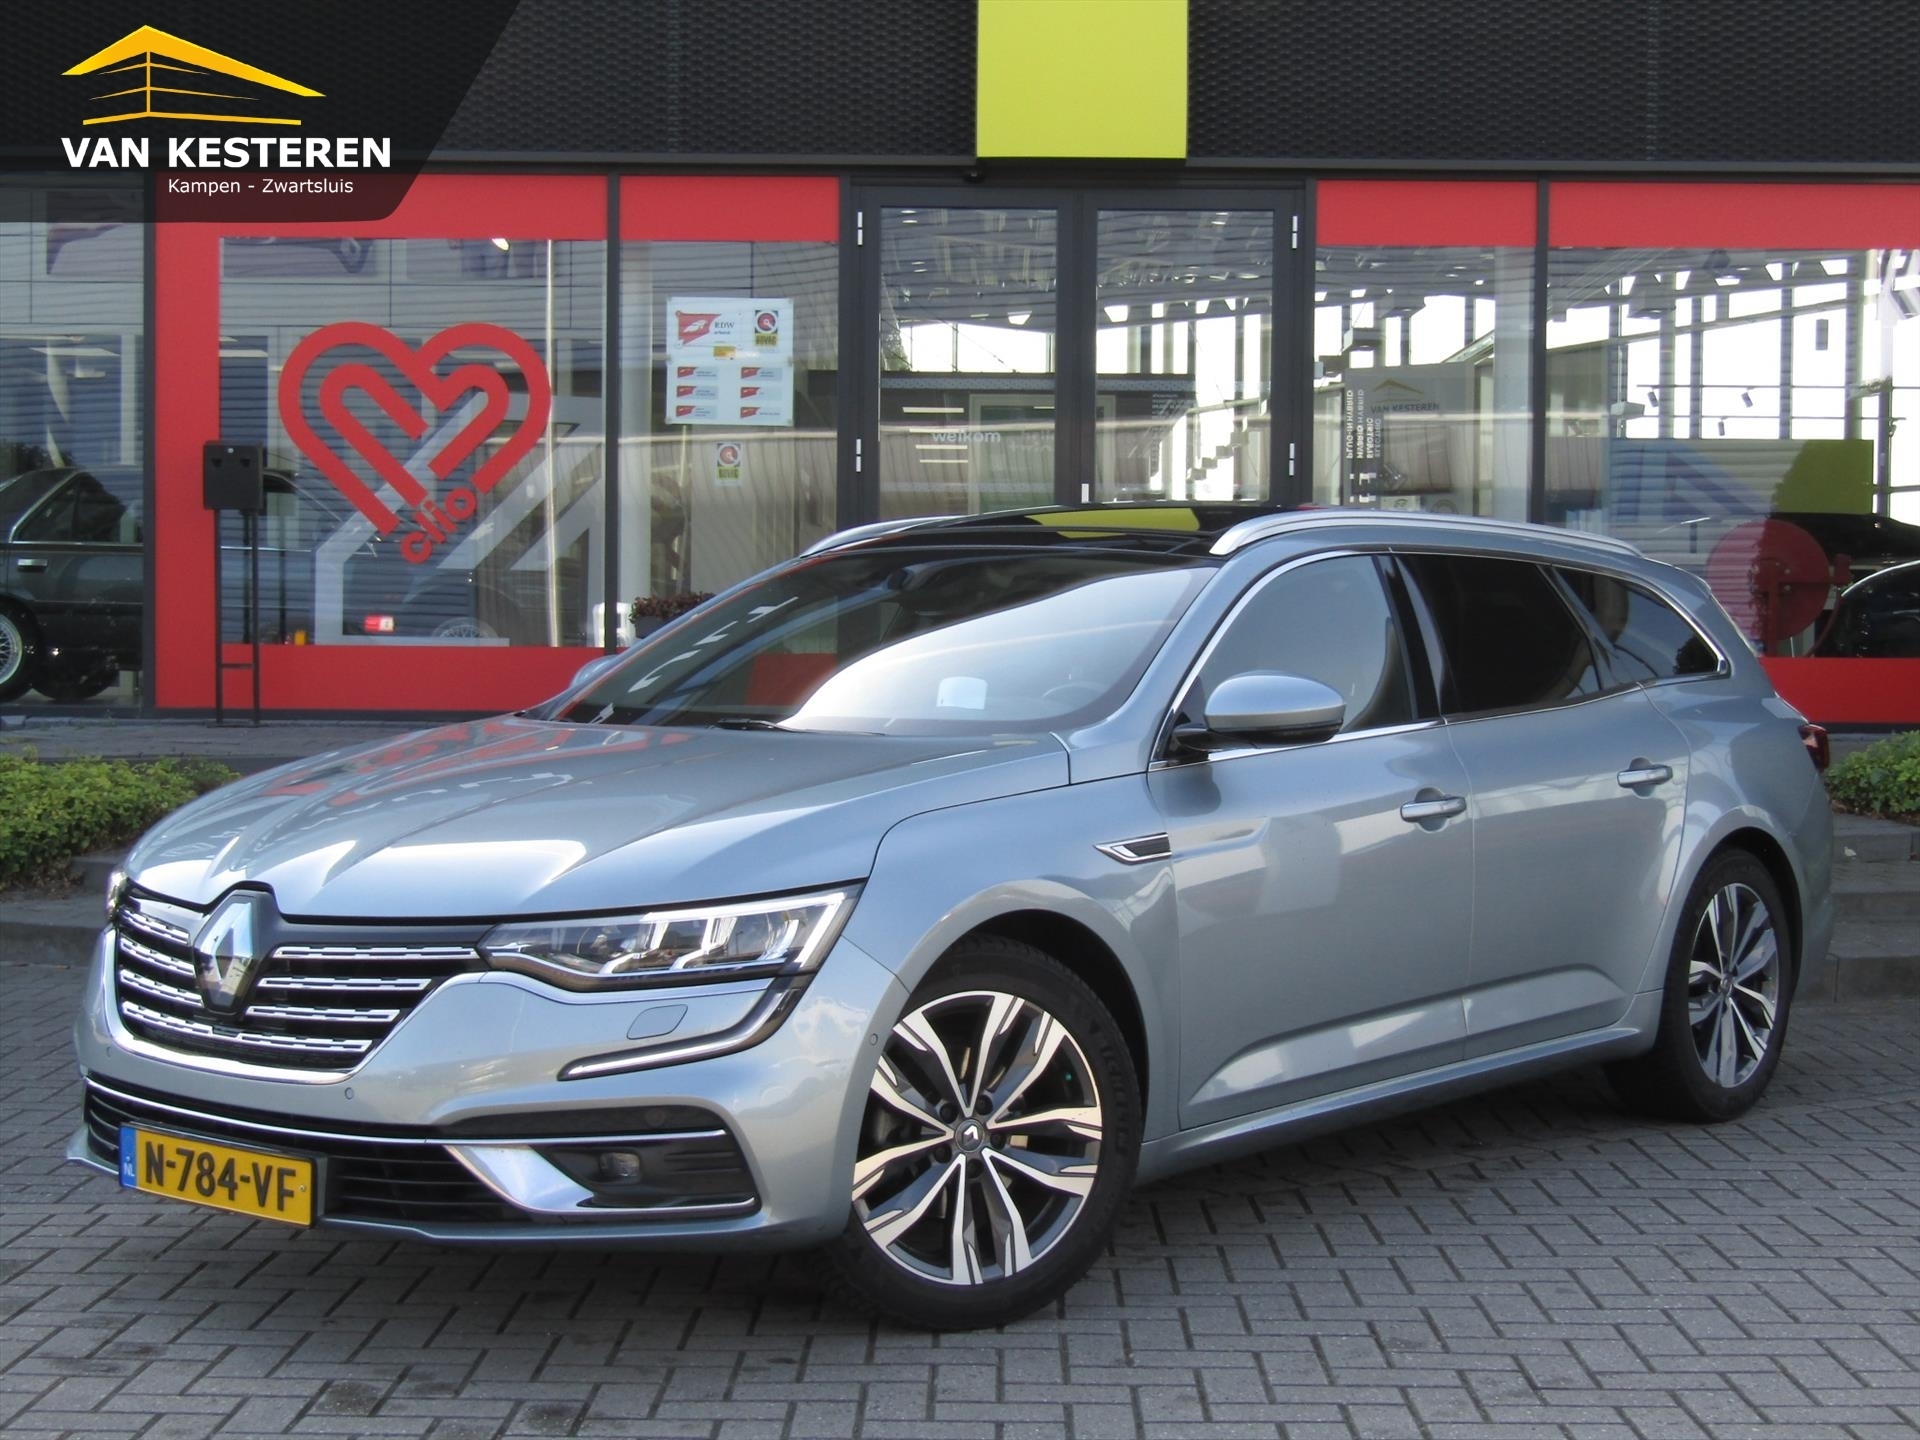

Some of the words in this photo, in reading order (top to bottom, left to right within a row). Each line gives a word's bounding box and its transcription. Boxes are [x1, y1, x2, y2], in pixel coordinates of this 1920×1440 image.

[932, 431, 1001, 442] welkom
[401, 486, 476, 564] clio
[123, 1162, 135, 1177] NL
[145, 1141, 296, 1211] N-784-VF
